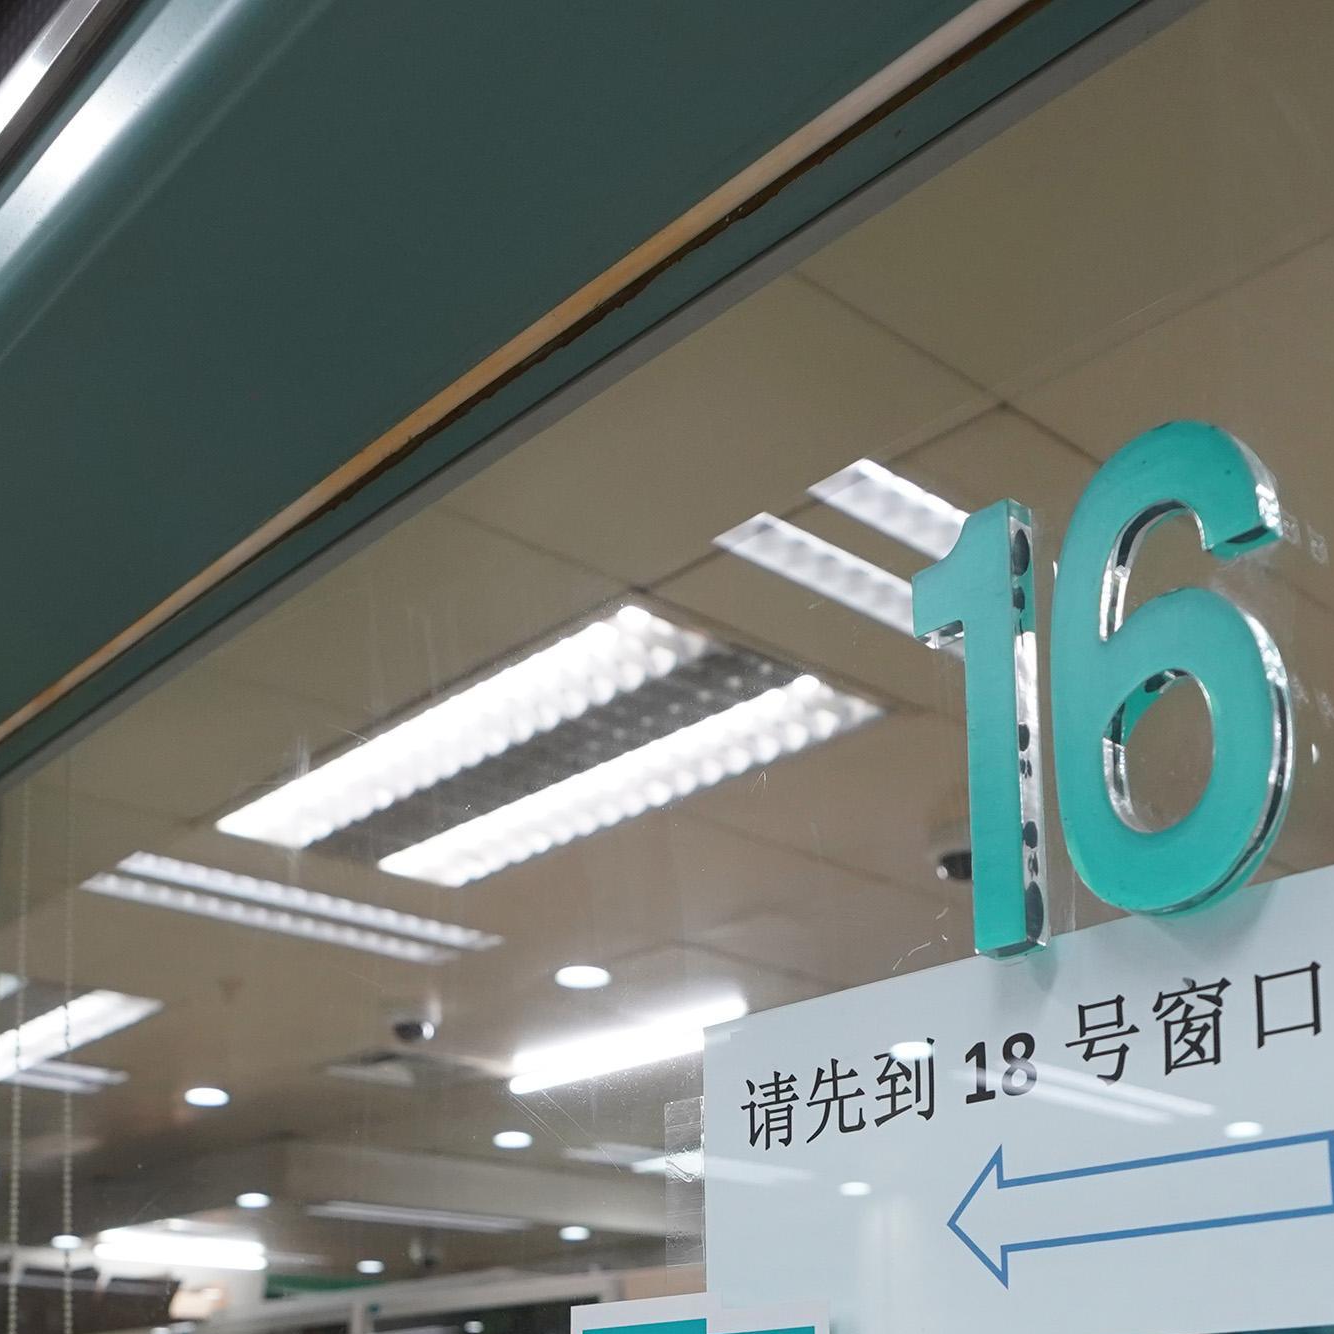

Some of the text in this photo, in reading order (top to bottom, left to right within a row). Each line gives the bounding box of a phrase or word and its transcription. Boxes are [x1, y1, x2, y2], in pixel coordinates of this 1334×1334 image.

[912, 420, 1293, 958] 16
[740, 1036, 935, 1151] 请先到
[963, 1031, 1038, 1105] 18
